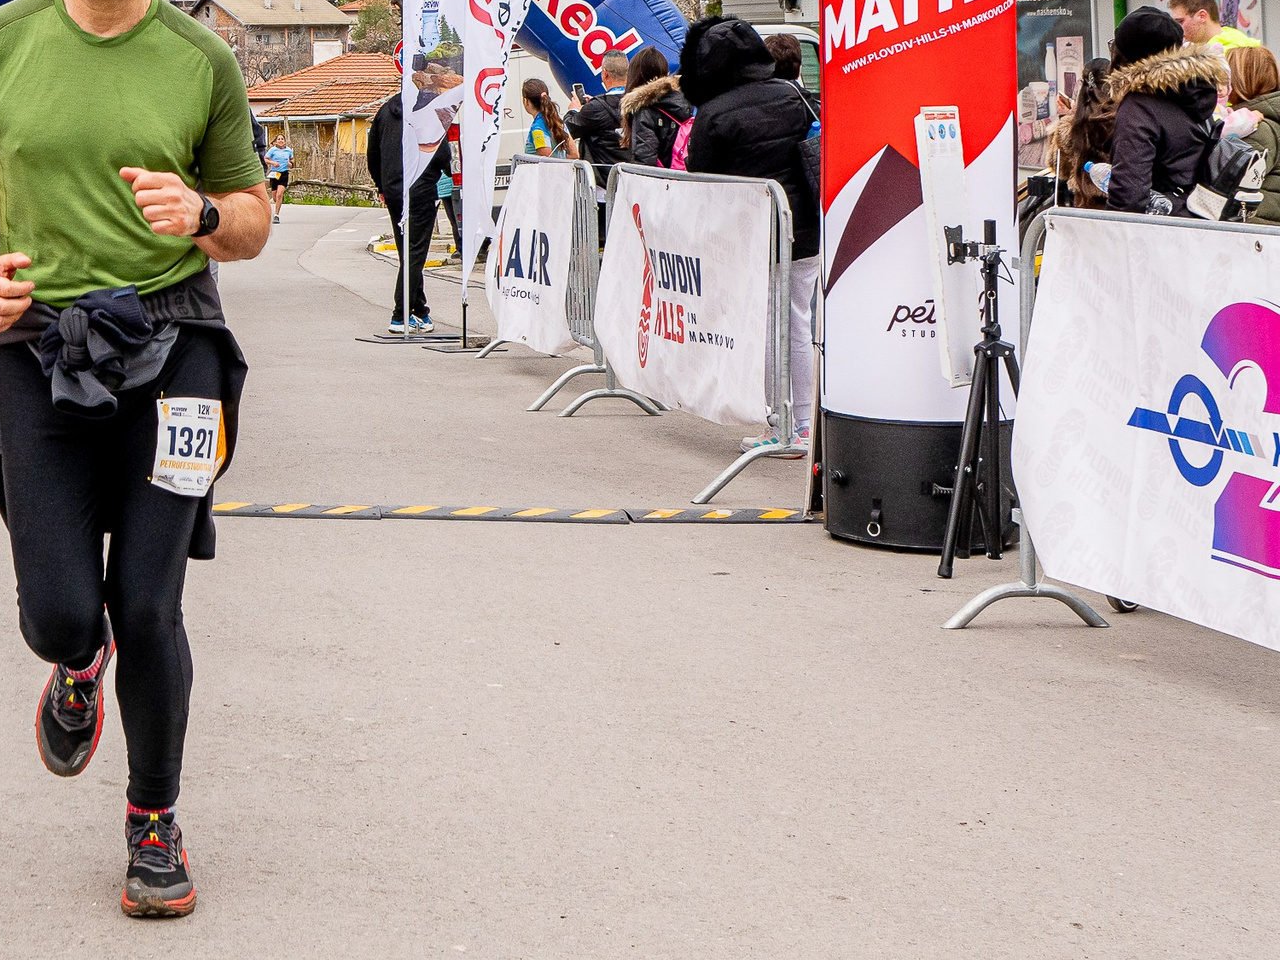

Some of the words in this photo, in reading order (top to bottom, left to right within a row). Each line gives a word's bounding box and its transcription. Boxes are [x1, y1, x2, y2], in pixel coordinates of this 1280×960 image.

[687, 312, 697, 324] IN
[689, 330, 735, 350] MARKOVO
[197, 404, 211, 415] 12K
[167, 425, 213, 460] 1321
